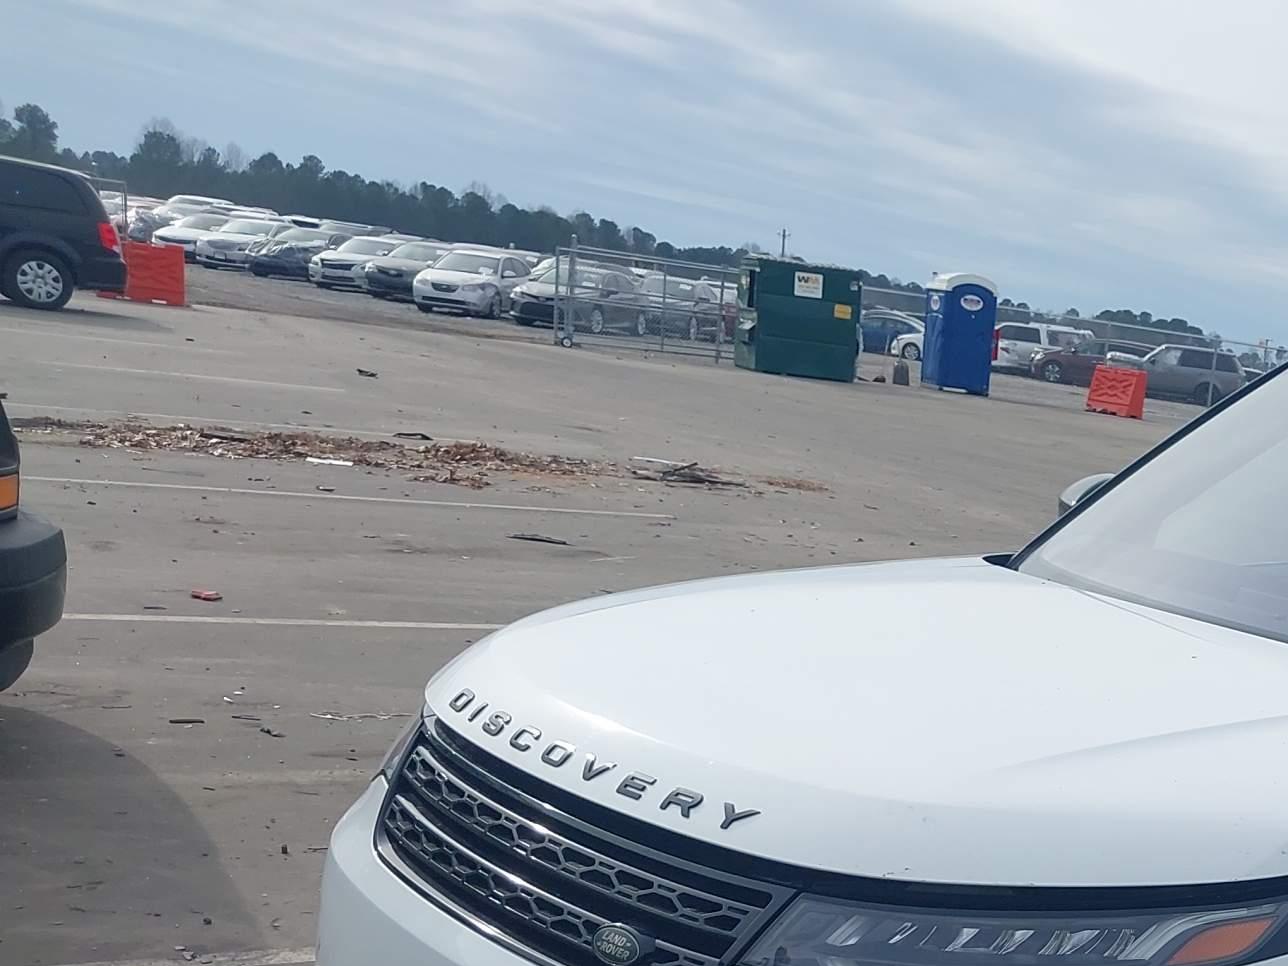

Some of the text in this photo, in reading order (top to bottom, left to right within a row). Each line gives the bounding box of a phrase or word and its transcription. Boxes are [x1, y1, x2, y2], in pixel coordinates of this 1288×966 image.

[449, 688, 761, 830] DISCOVERY
[602, 931, 627, 946] LAND
[600, 941, 630, 960] ROVER
